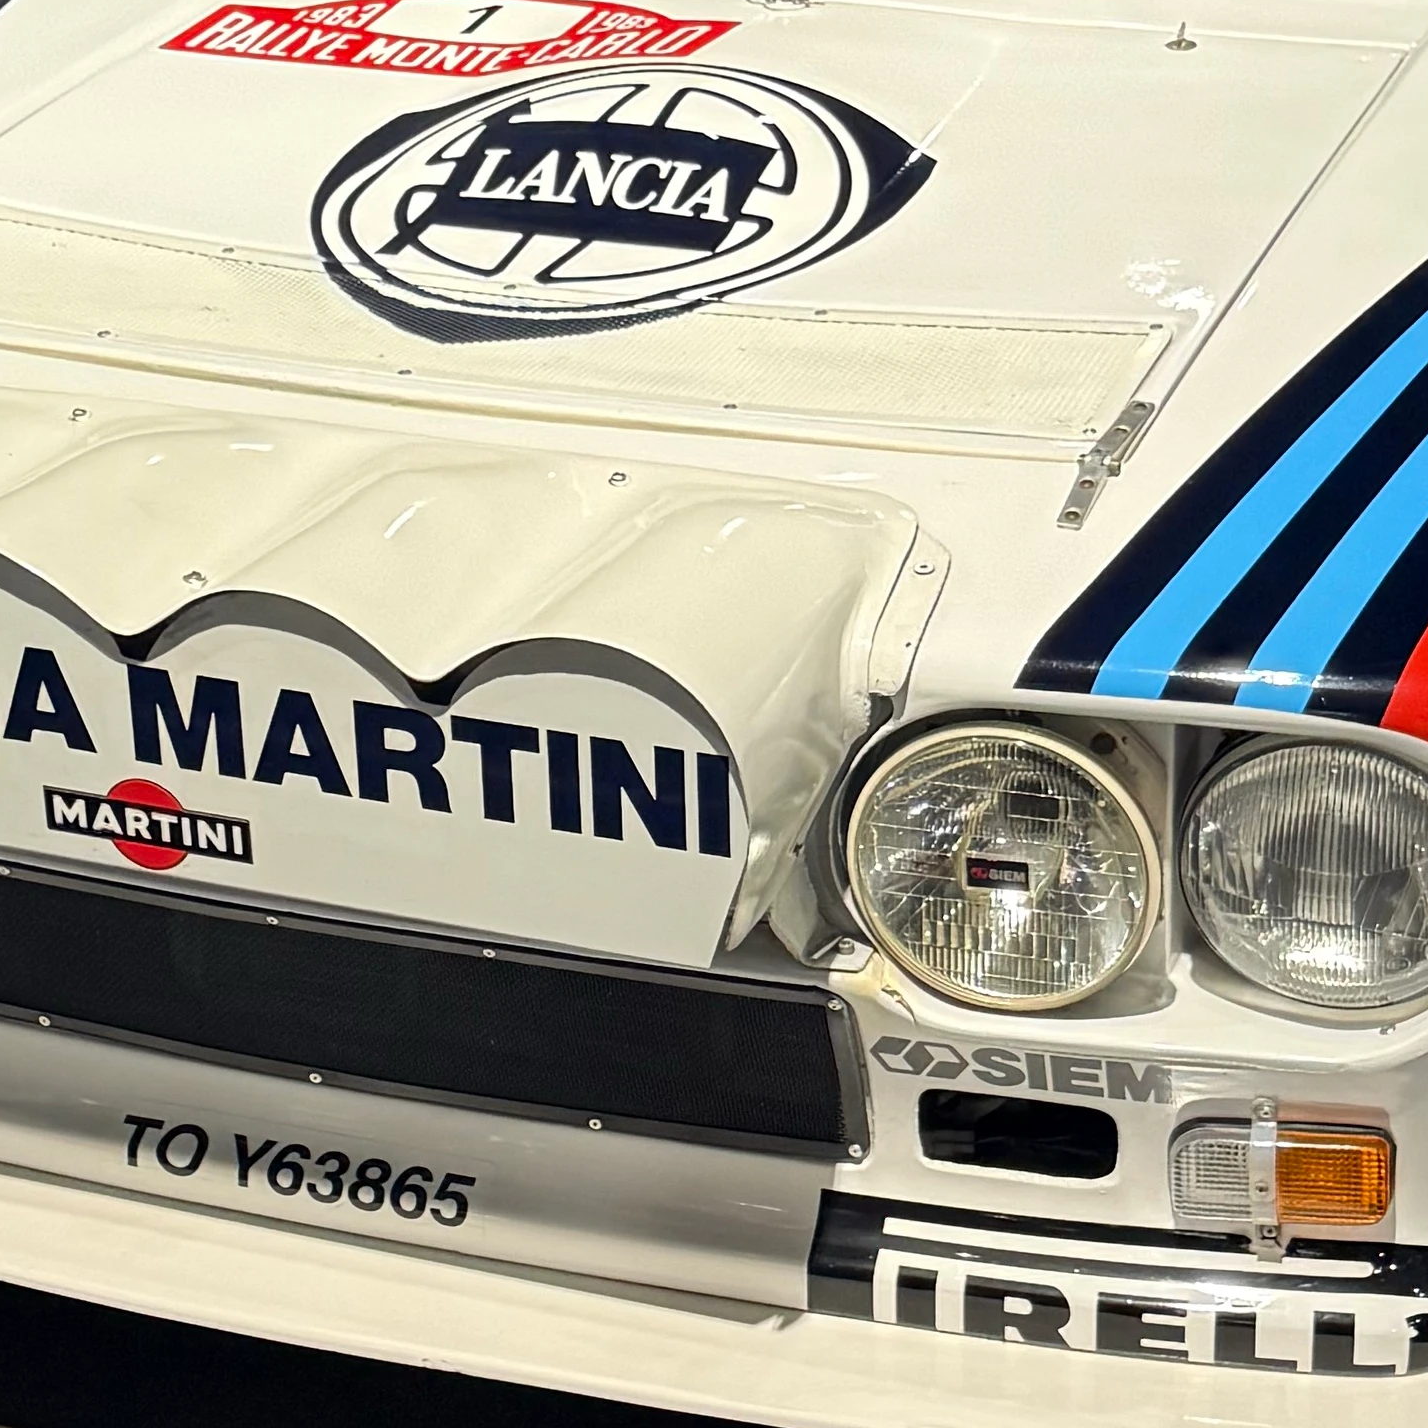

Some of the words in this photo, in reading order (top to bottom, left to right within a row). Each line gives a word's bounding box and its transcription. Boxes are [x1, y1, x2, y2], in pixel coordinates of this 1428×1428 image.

[186, 11, 362, 61] RALLYE
[354, 25, 701, 74] MONTE-CARLO
[294, 2, 384, 29] 1983
[459, 5, 505, 34] 1
[576, 9, 665, 35] 1983
[459, 145, 731, 223] LANCIA
[128, 663, 732, 858] MARTINI
[52, 795, 246, 856] MARTINI
[972, 1048, 1174, 1103] SIEM
[124, 1115, 209, 1176] TO
[234, 1134, 476, 1227] Y63865
